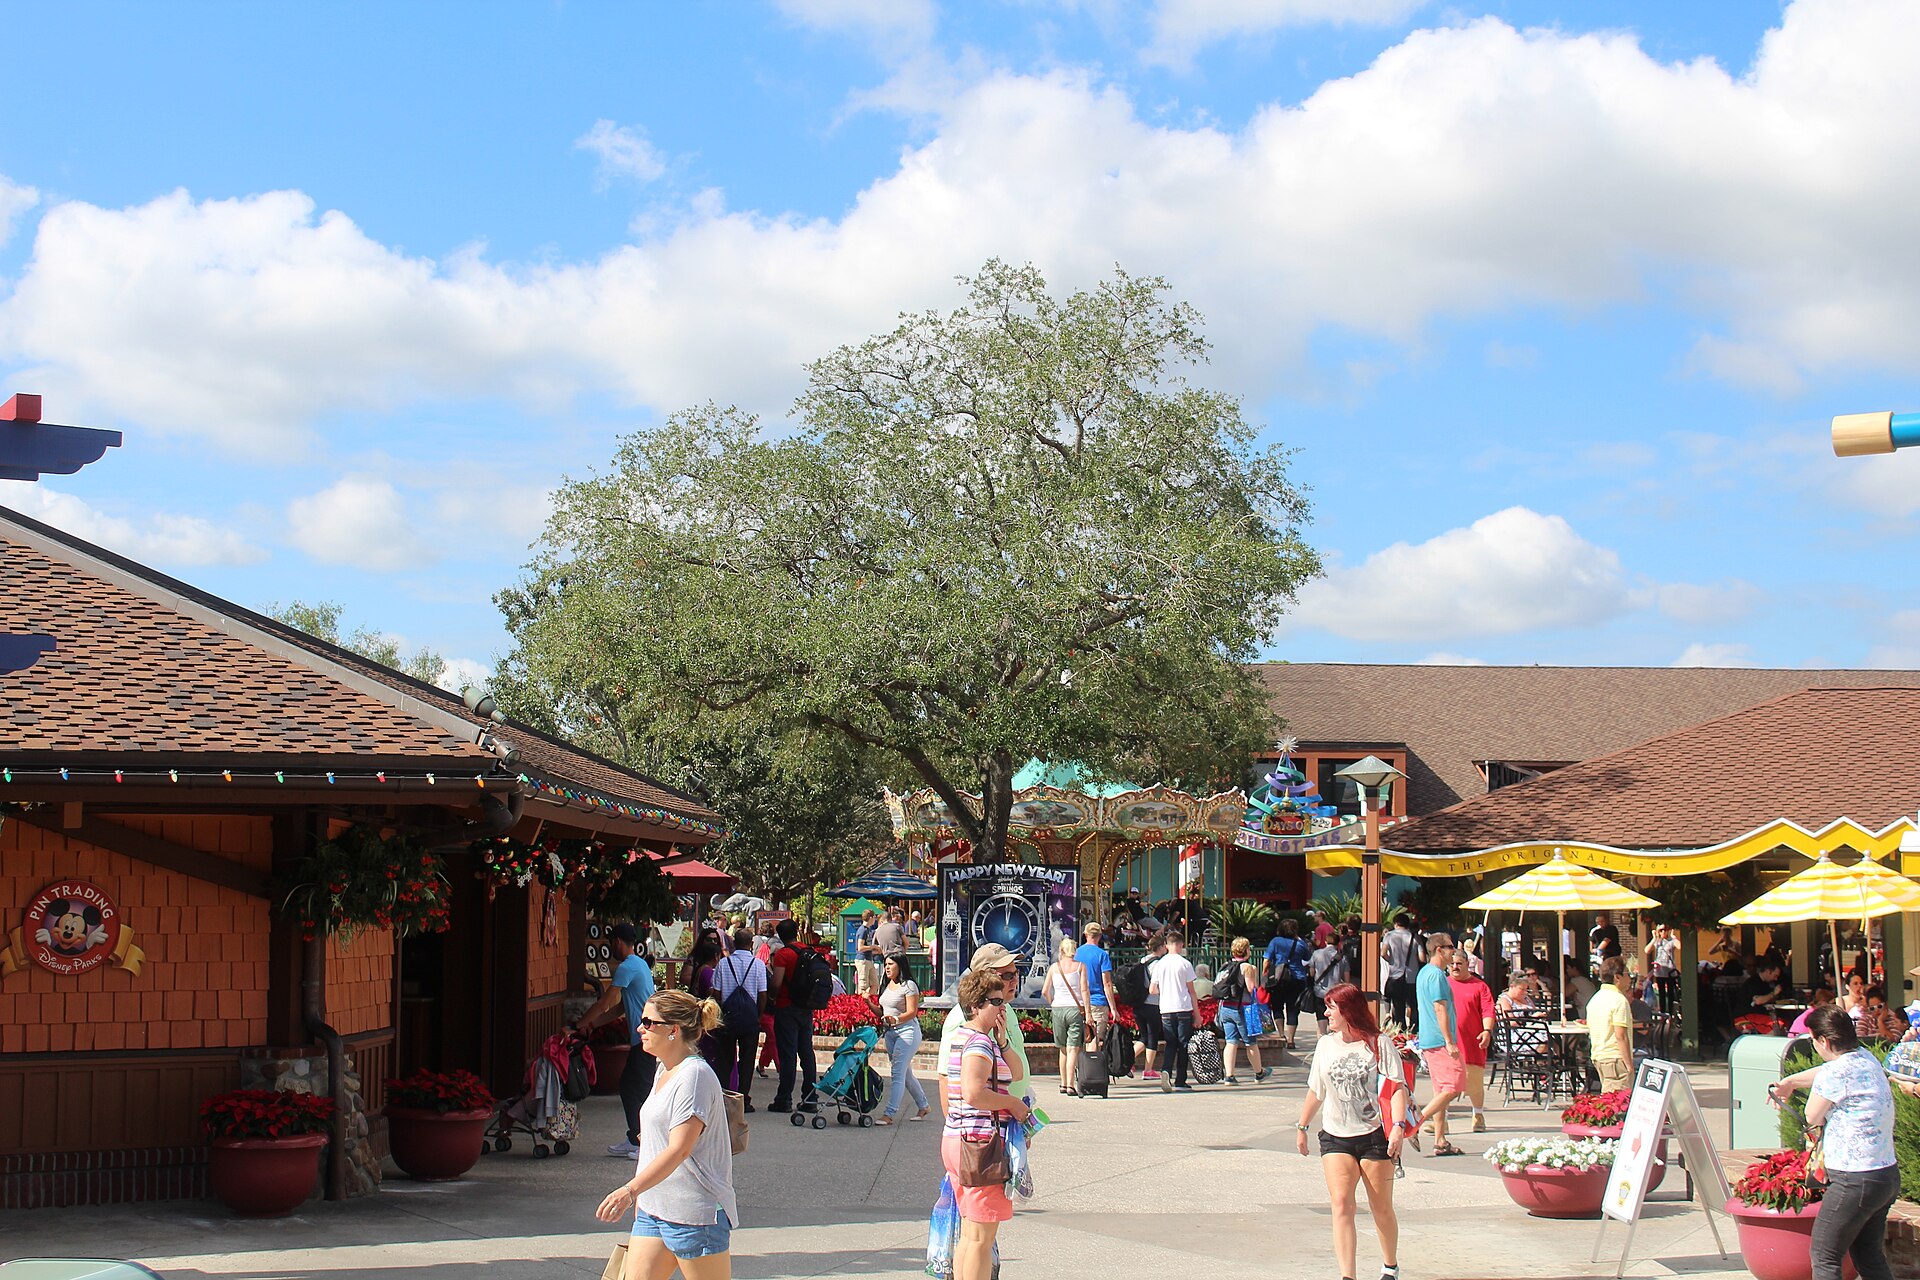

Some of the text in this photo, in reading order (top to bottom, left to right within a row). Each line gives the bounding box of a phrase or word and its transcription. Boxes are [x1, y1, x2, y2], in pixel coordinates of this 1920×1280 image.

[1448, 849, 1668, 872] THE ORIGNAL 1762
[948, 863, 1067, 884] HAPPY NEW YEAR!
[992, 885, 1024, 895] SPRINGS
[29, 885, 114, 920] PIN TRADING
